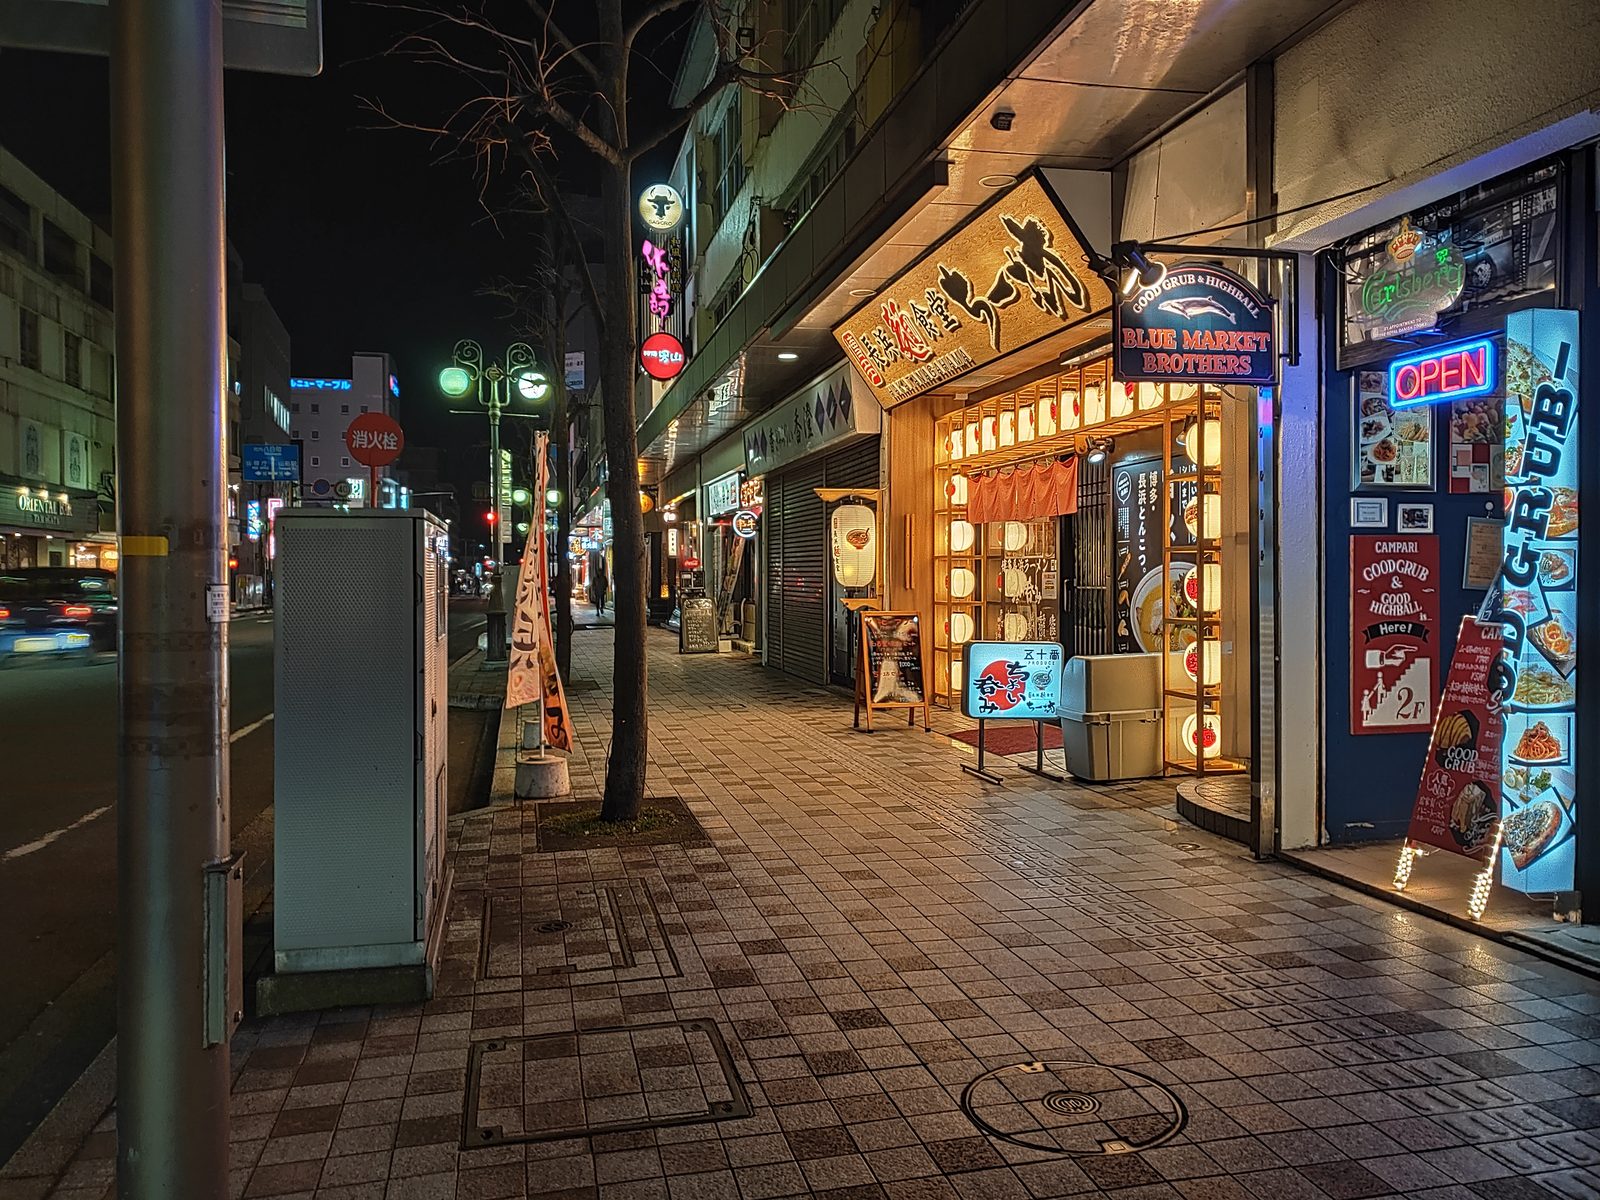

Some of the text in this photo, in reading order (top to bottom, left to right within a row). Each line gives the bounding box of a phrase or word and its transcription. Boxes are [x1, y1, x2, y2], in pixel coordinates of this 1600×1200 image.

[1133, 273, 1260, 319] GOOD GRUB & HIGHBALL
[1362, 263, 1463, 316] Carlsberg
[1122, 328, 1271, 352] BLUE MARKET
[1142, 353, 1252, 375] BROTHERS
[1395, 347, 1485, 401] OPEN
[352, 430, 398, 450] 消火栓
[18, 494, 58, 514] ORIENTAL
[1137, 472, 1147, 573] 長浜とんこつ。
[1375, 541, 1419, 554] CAMPARI
[1362, 559, 1430, 582] GOOD GRUB
[1390, 575, 1403, 589] &
[1369, 599, 1422, 617] HIGHBALL
[1380, 592, 1411, 605] GOOD
[1379, 622, 1413, 635] Here!
[1005, 660, 1031, 703] ちょい
[973, 675, 1005, 714] 呑み
[1396, 687, 1425, 721] 2F
[1026, 700, 1056, 714] ちー坊
[1447, 746, 1479, 762] GOOD
[1444, 757, 1477, 774] GRUB
